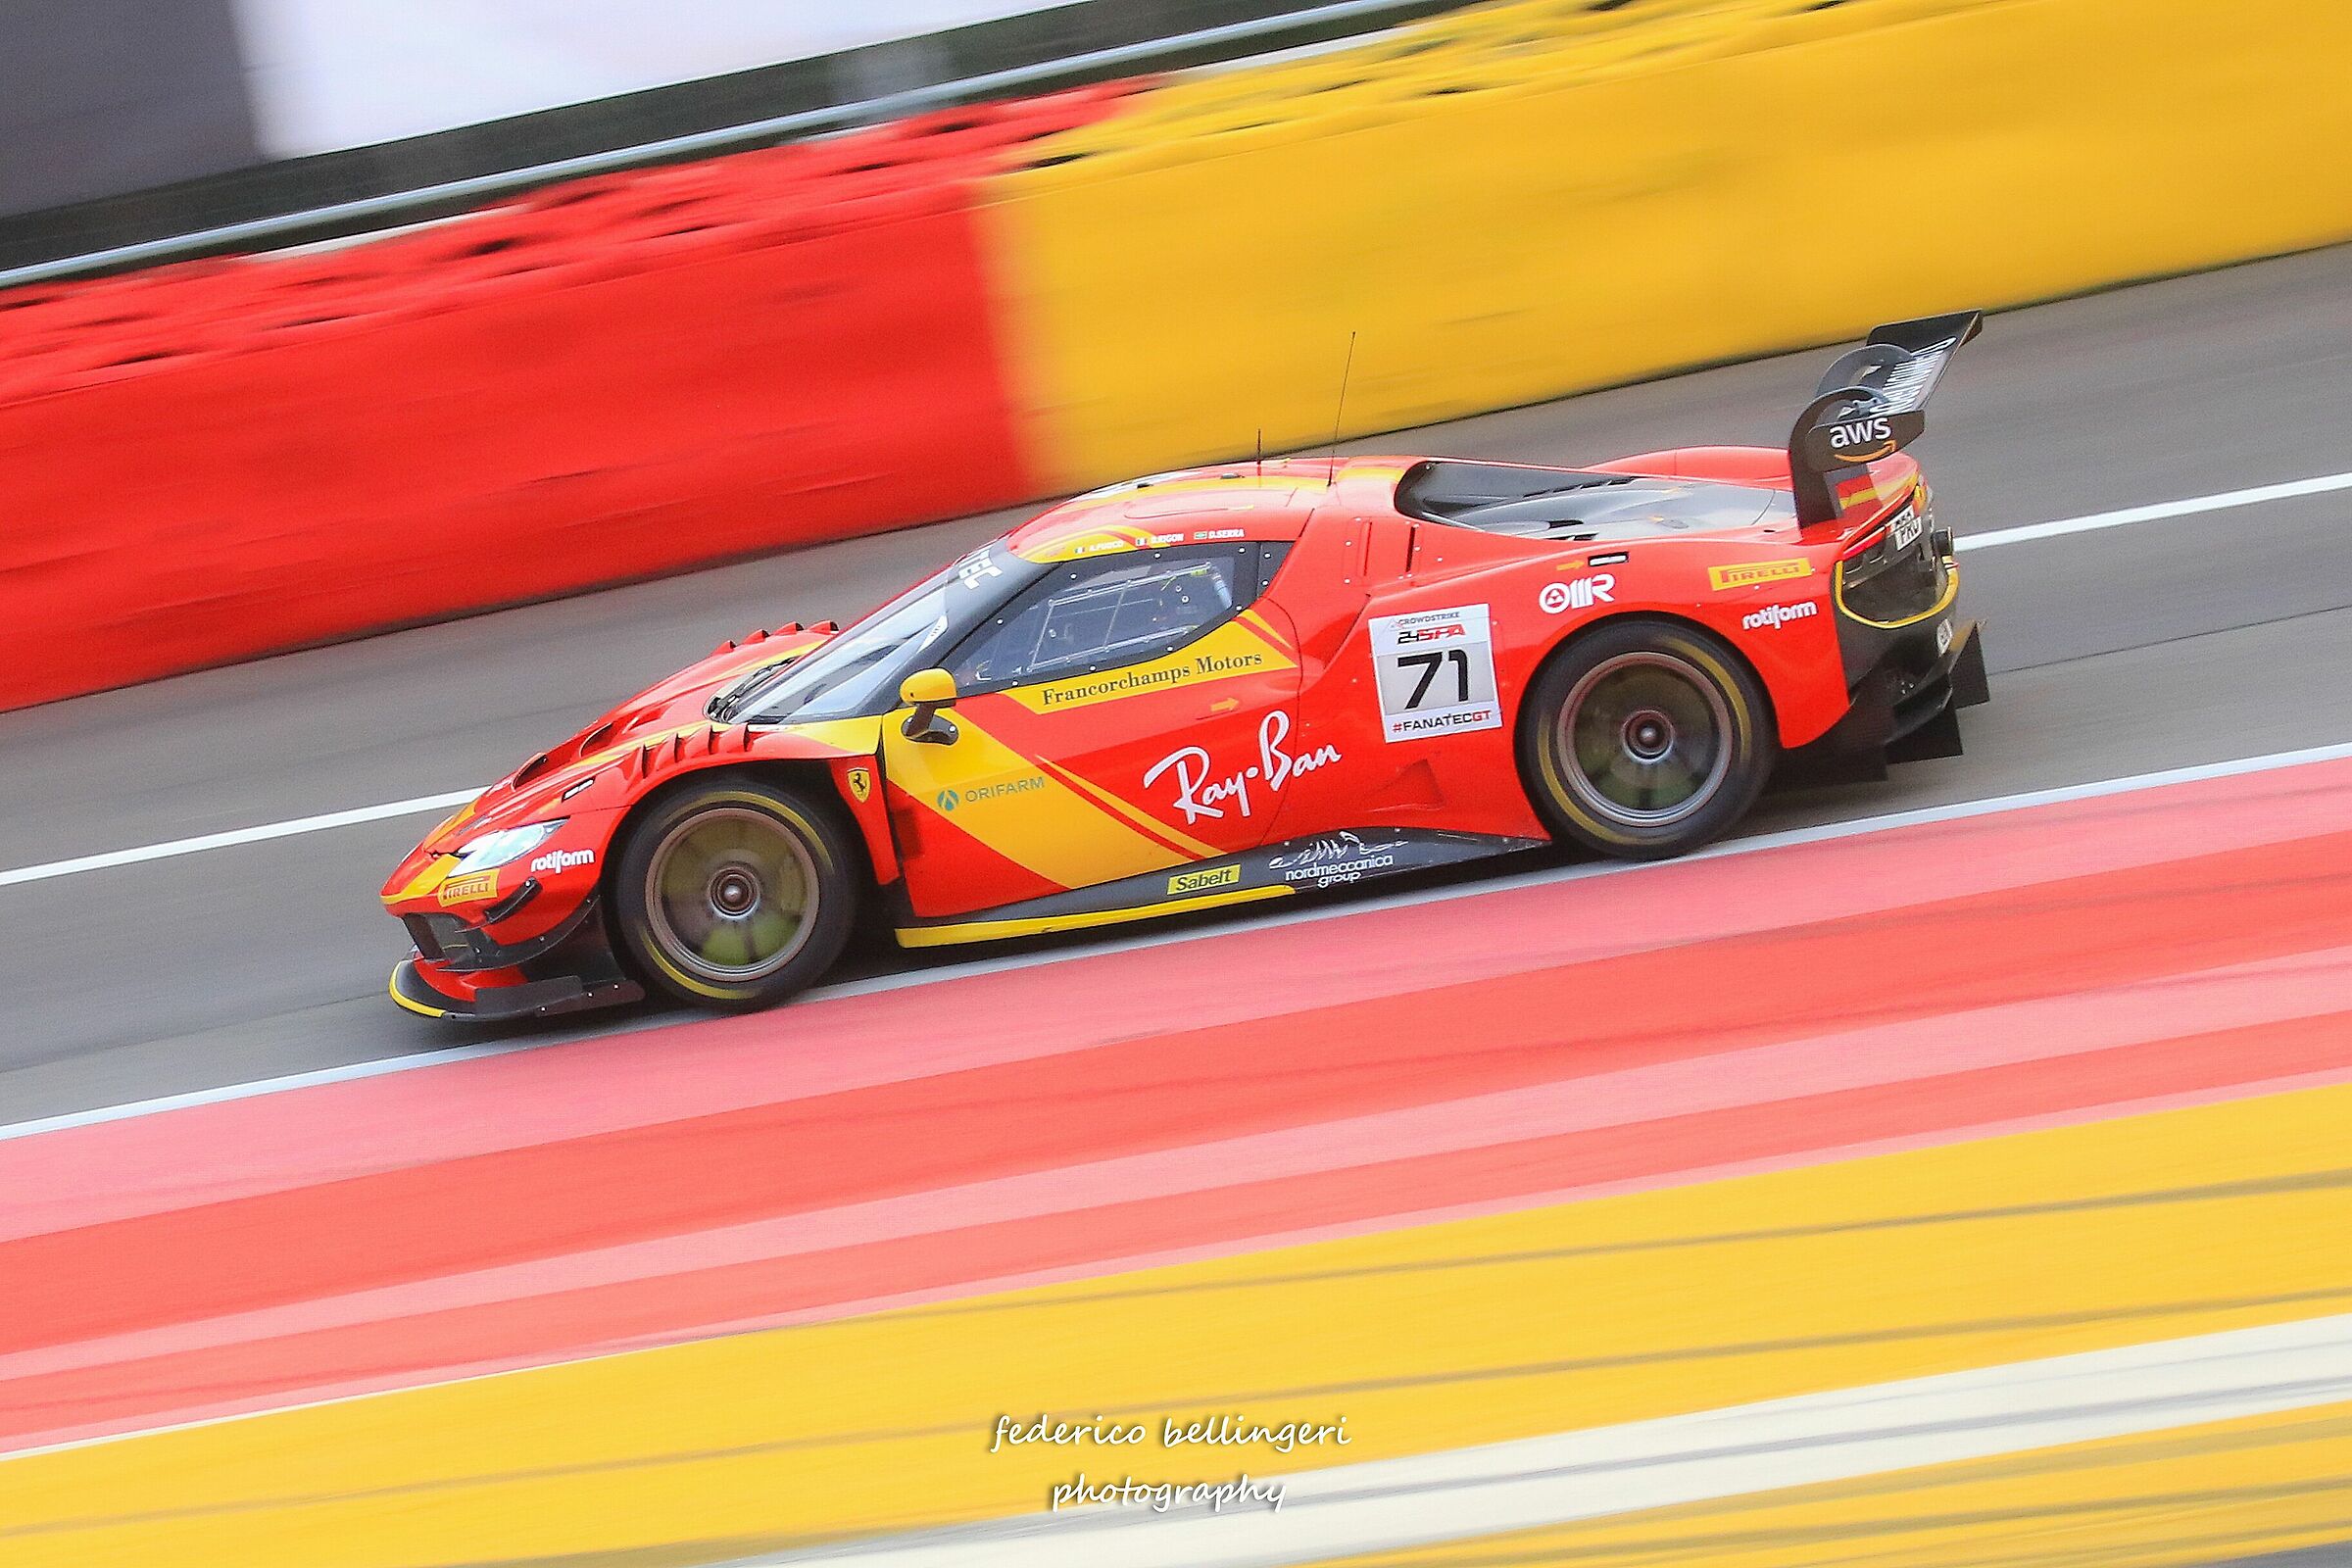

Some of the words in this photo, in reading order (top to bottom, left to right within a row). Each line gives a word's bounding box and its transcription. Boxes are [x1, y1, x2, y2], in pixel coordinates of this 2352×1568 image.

[1830, 416, 1891, 448] aws
[1720, 563, 1799, 583] PIRELLI
[1397, 612, 1460, 627] CROWDSTRIKE
[1742, 602, 1817, 629] rotiform
[1043, 664, 1190, 706] Francorchamps
[1196, 653, 1262, 673] Motors
[1397, 650, 1468, 710] 71
[965, 776, 1045, 803] ORIFARM
[531, 849, 595, 873] rotiform
[1286, 855, 1393, 881] nordmeccanica
[1176, 869, 1231, 891] Sabelt
[1318, 871, 1361, 888] group
